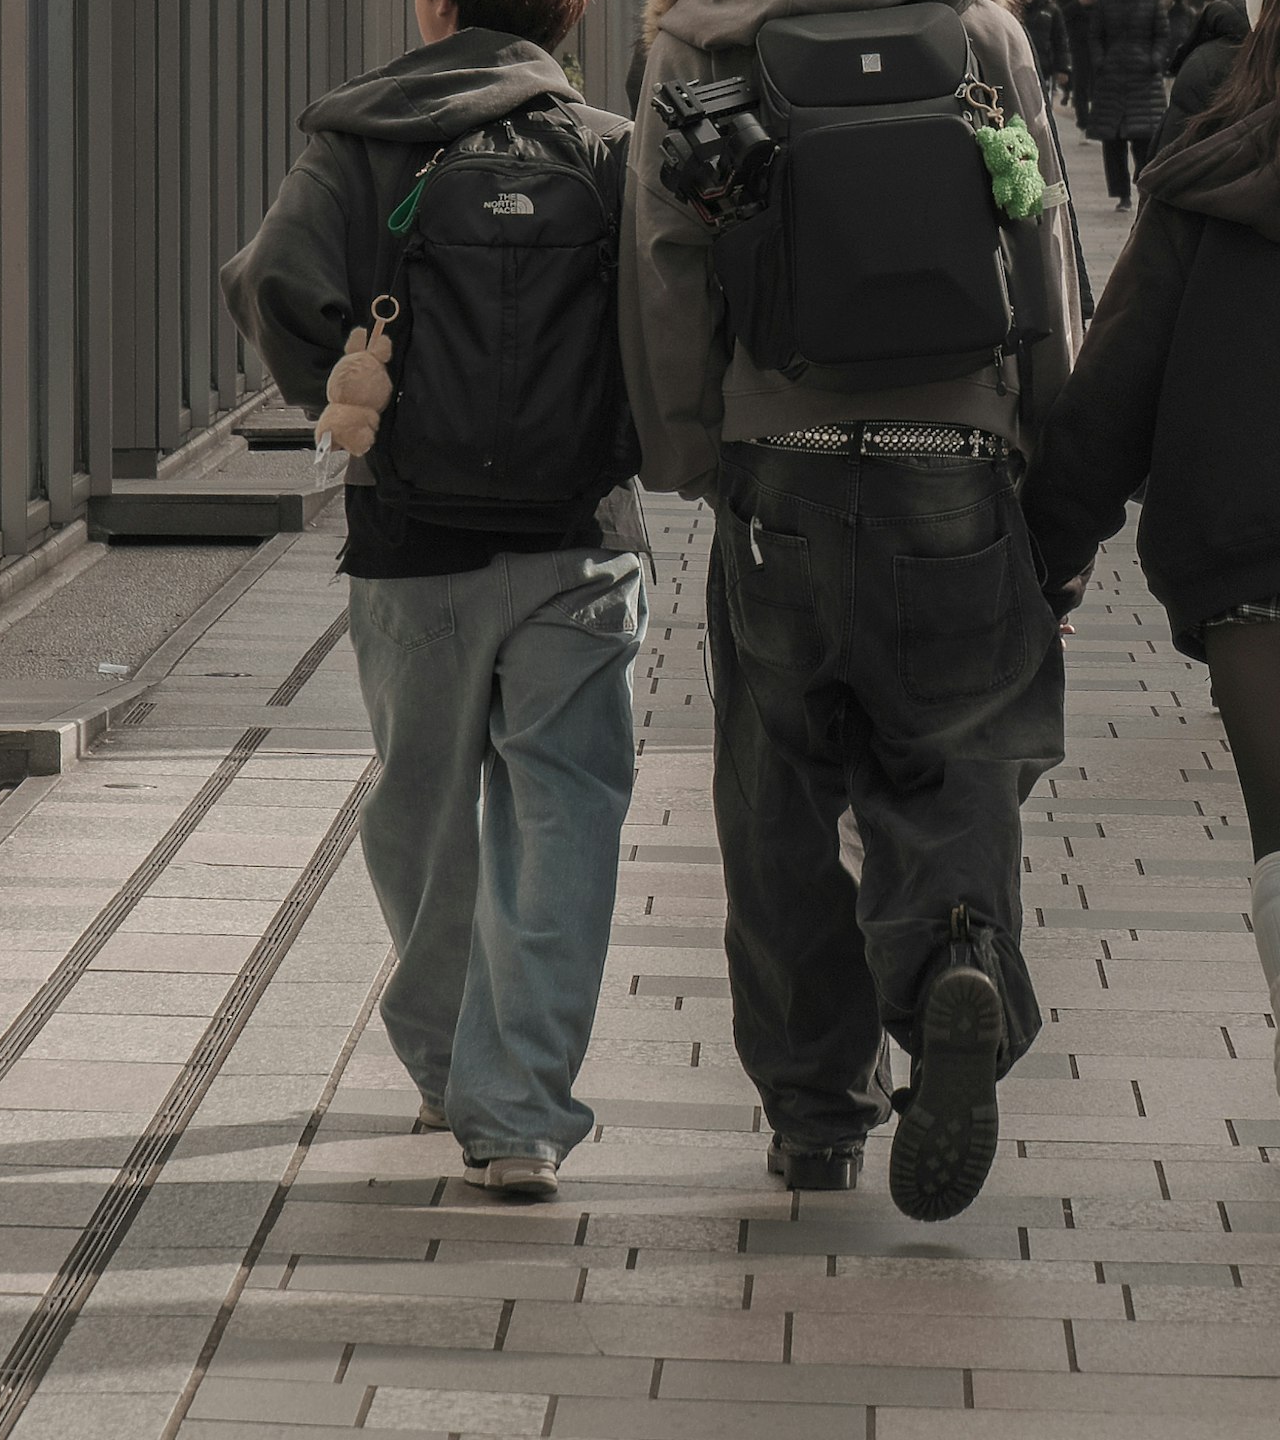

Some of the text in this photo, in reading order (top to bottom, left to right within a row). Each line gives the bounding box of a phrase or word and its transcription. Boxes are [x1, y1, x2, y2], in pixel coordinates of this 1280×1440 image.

[497, 192, 516, 201] THE
[483, 200, 517, 209] NORTH
[492, 207, 518, 215] FACE
